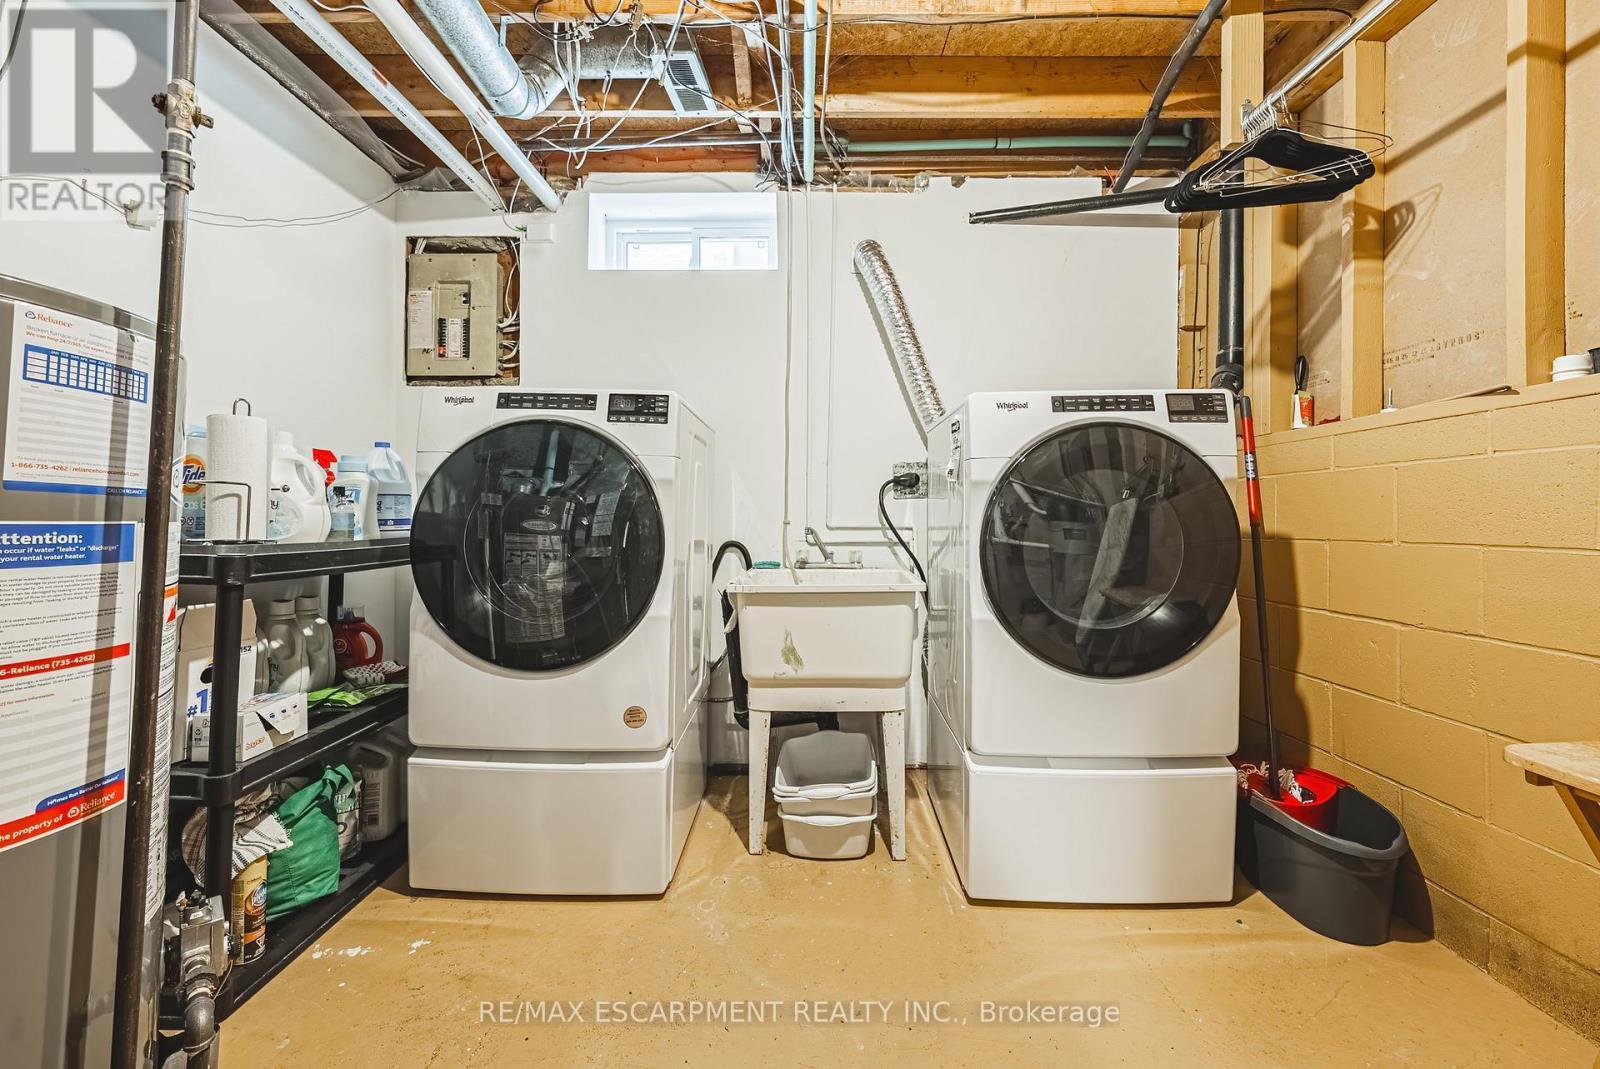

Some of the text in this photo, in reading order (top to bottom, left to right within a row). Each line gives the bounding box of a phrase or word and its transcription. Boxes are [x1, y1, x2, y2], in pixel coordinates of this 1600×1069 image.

[37, 313, 73, 328] Reliance
[445, 396, 475, 406] Whirlpool
[996, 402, 1029, 412] Whirlpool
[11, 462, 68, 472] 1-866-735-4262
[183, 465, 205, 484] Tide
[0, 532, 83, 545] ttention:
[0, 663, 50, 676] 6-Reliance
[51, 654, 96, 668] (735-4262)
[13, 818, 52, 839] property
[54, 814, 63, 823] of
[80, 792, 116, 812] Reliance
